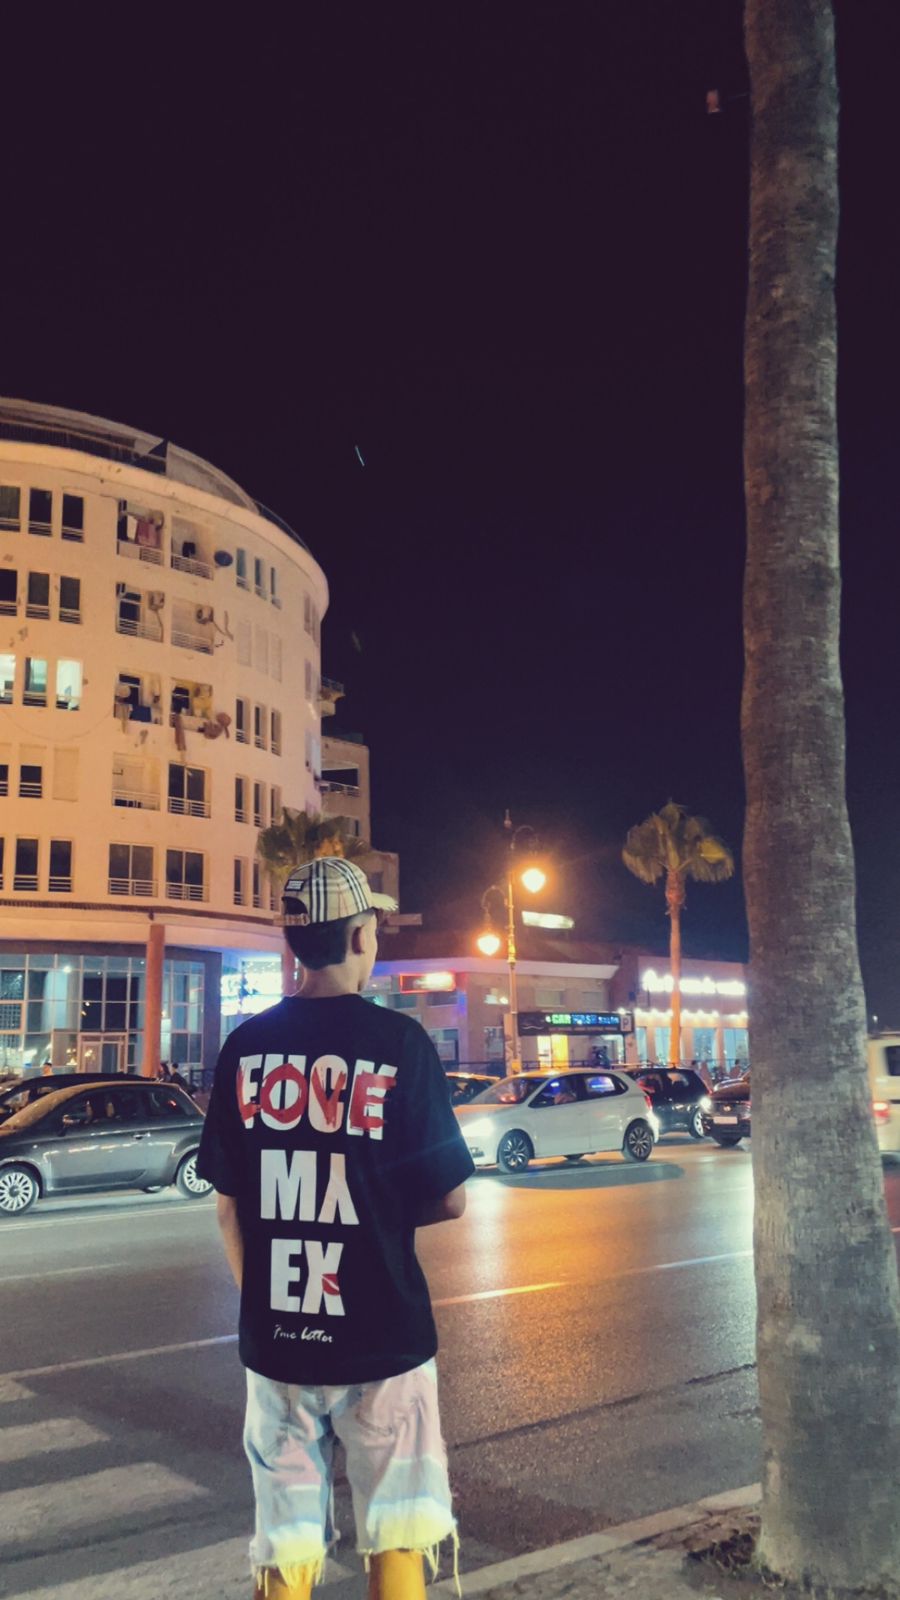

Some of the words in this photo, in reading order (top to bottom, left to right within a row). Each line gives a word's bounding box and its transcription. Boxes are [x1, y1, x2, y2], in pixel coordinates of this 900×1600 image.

[551, 1013, 571, 1025] CAR
[260, 1149, 360, 1225] MY
[270, 1238, 346, 1316] EX
